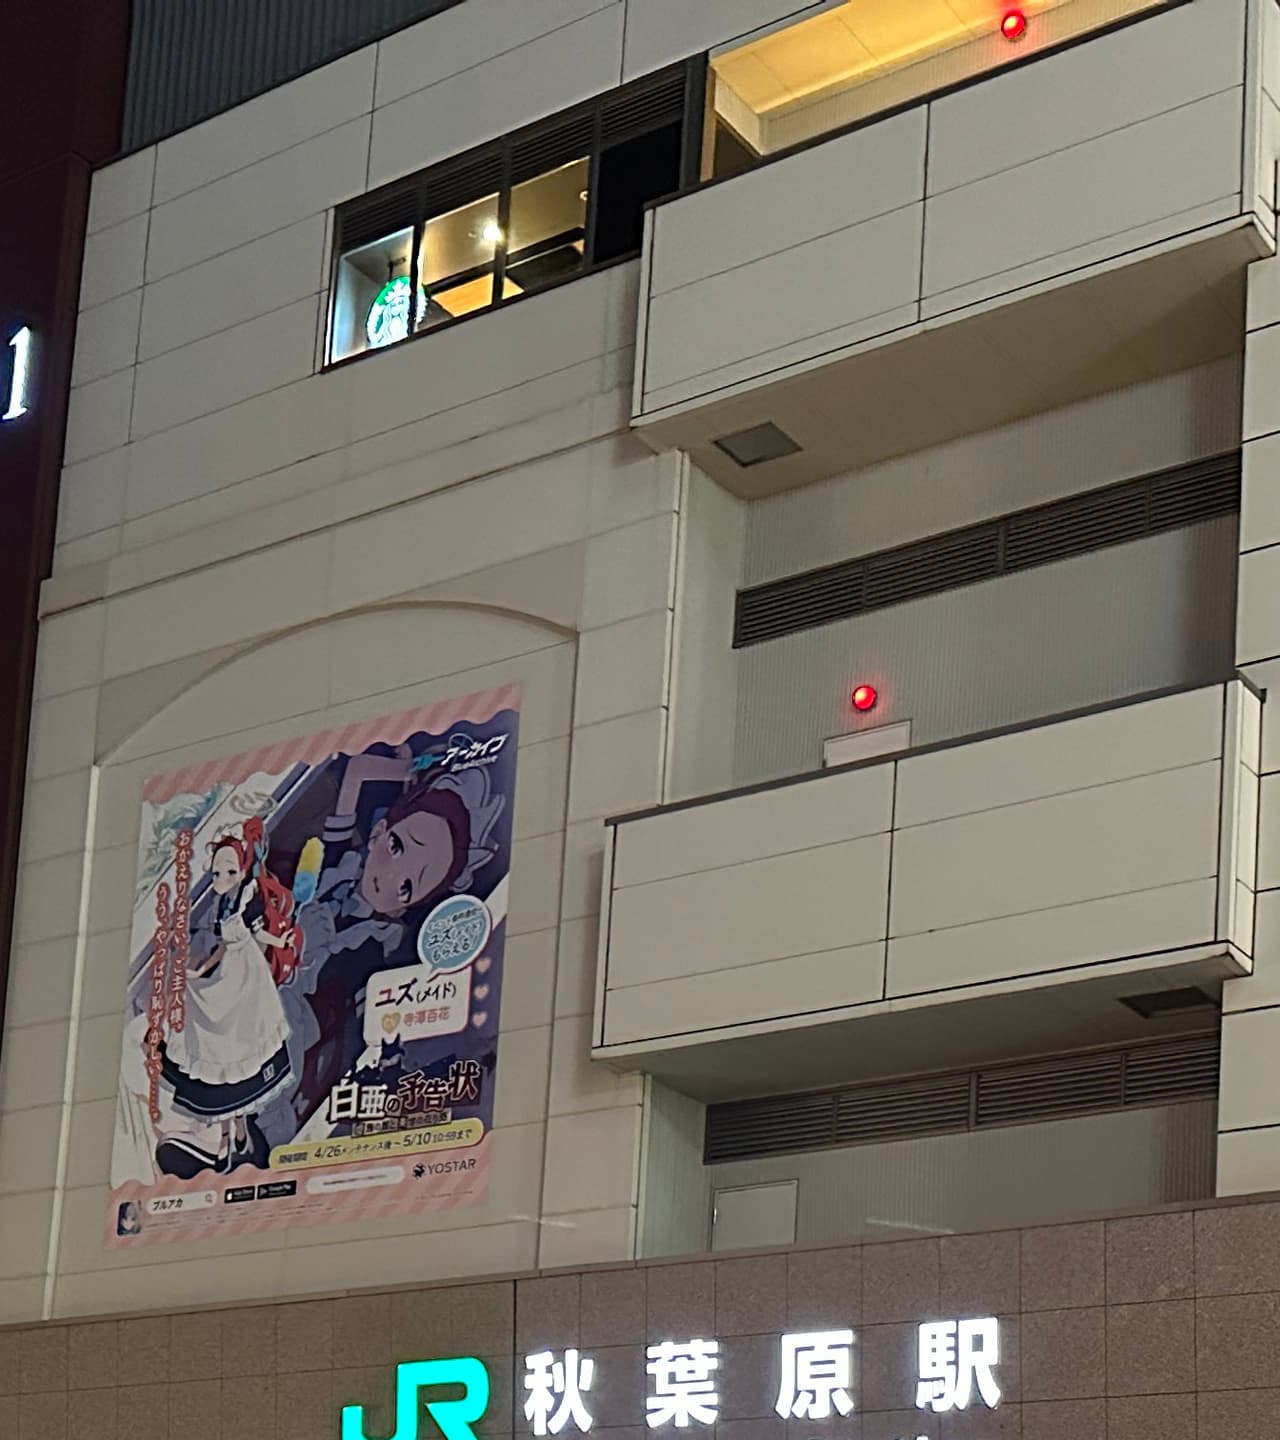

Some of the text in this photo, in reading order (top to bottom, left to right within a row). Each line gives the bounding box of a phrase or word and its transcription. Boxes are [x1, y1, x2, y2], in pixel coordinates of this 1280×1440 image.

[427, 1158, 477, 1175] YOSTAR
[522, 1315, 1002, 1438] 秋葉原駅
